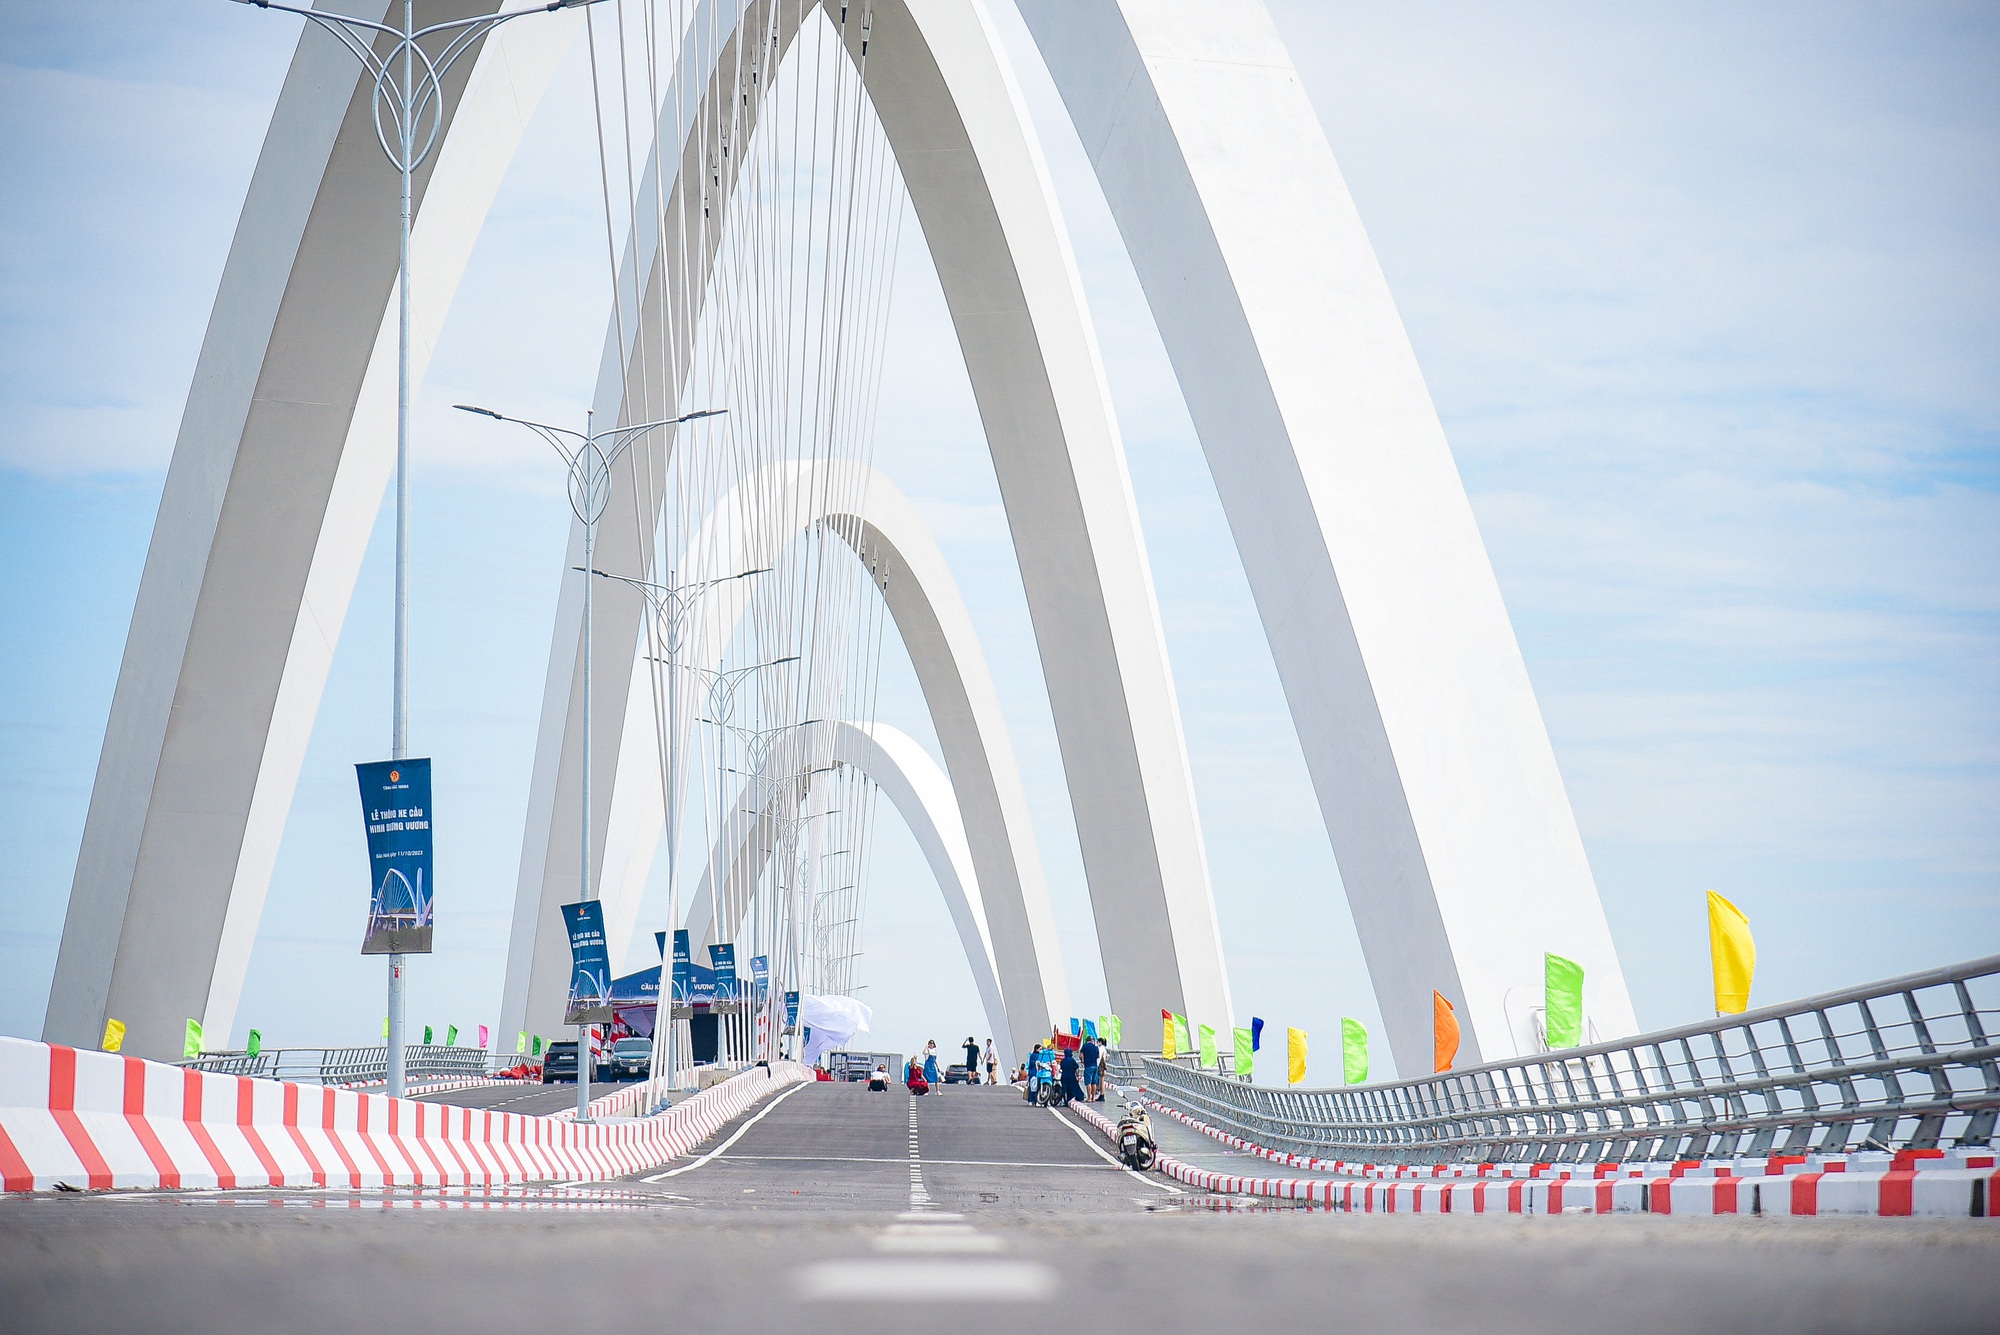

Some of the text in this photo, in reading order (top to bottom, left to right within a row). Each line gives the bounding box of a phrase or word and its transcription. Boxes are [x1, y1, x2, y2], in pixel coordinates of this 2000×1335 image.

[371, 809, 379, 821] LỄ
[398, 809, 407, 818] XE
[409, 806, 423, 817] CẦU
[406, 821, 429, 830] VƯƠNG
